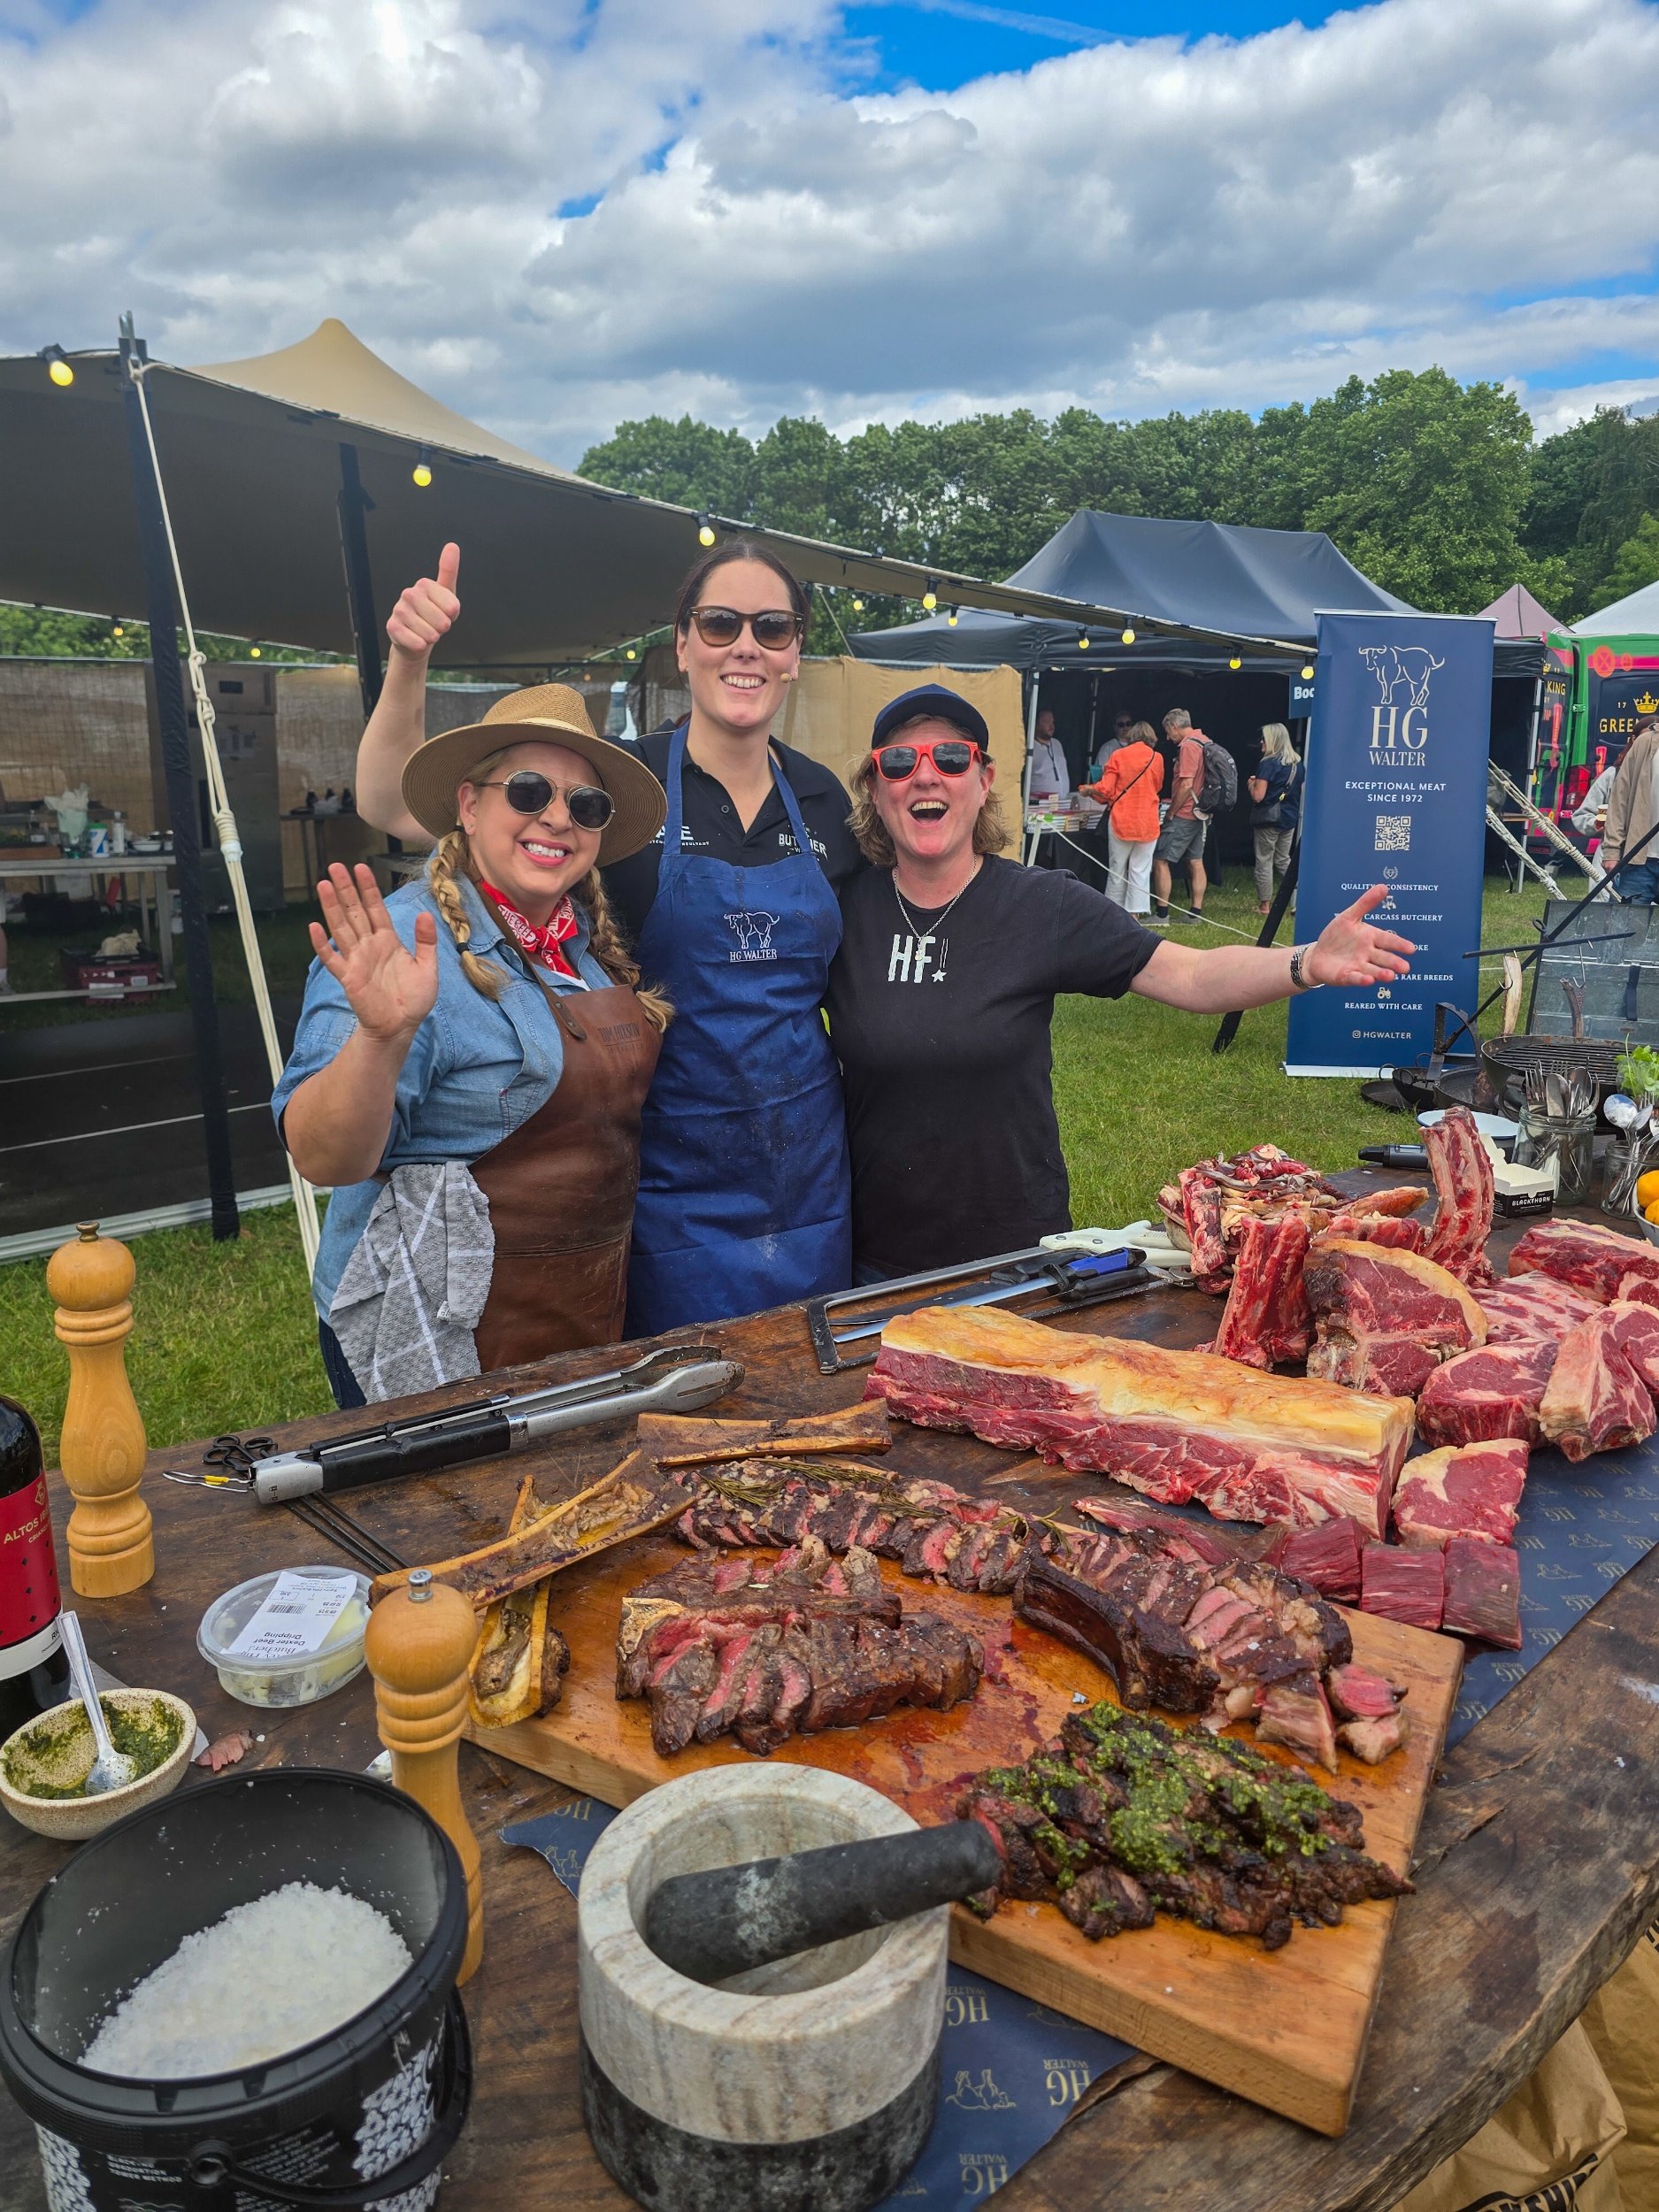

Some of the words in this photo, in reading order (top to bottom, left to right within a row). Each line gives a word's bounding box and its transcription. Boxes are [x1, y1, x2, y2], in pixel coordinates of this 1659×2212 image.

[1547, 680, 1566, 695] KING
[1369, 707, 1428, 749] HG
[1600, 718, 1640, 733] GREE
[1369, 751, 1425, 767] WALTER
[1345, 780, 1417, 791] EXCEPTIONAL
[1418, 782, 1447, 791] MEAT
[1367, 794, 1398, 803] SINCE
[779, 833, 828, 860] BUTER
[729, 951, 741, 961] HG
[743, 949, 778, 961] WALTER
[1363, 1031, 1412, 1040] HGWALTER
[1511, 1195, 1551, 1207] BLACKTHORN
[4, 1517, 39, 1545] ALTOS
[946, 1995, 990, 2026] HG
[1043, 2058, 1090, 2070] WALTER
[1046, 2070, 1092, 2107] HG
[959, 2153, 1008, 2165] WALTER
[961, 2164, 1009, 2195] HG
